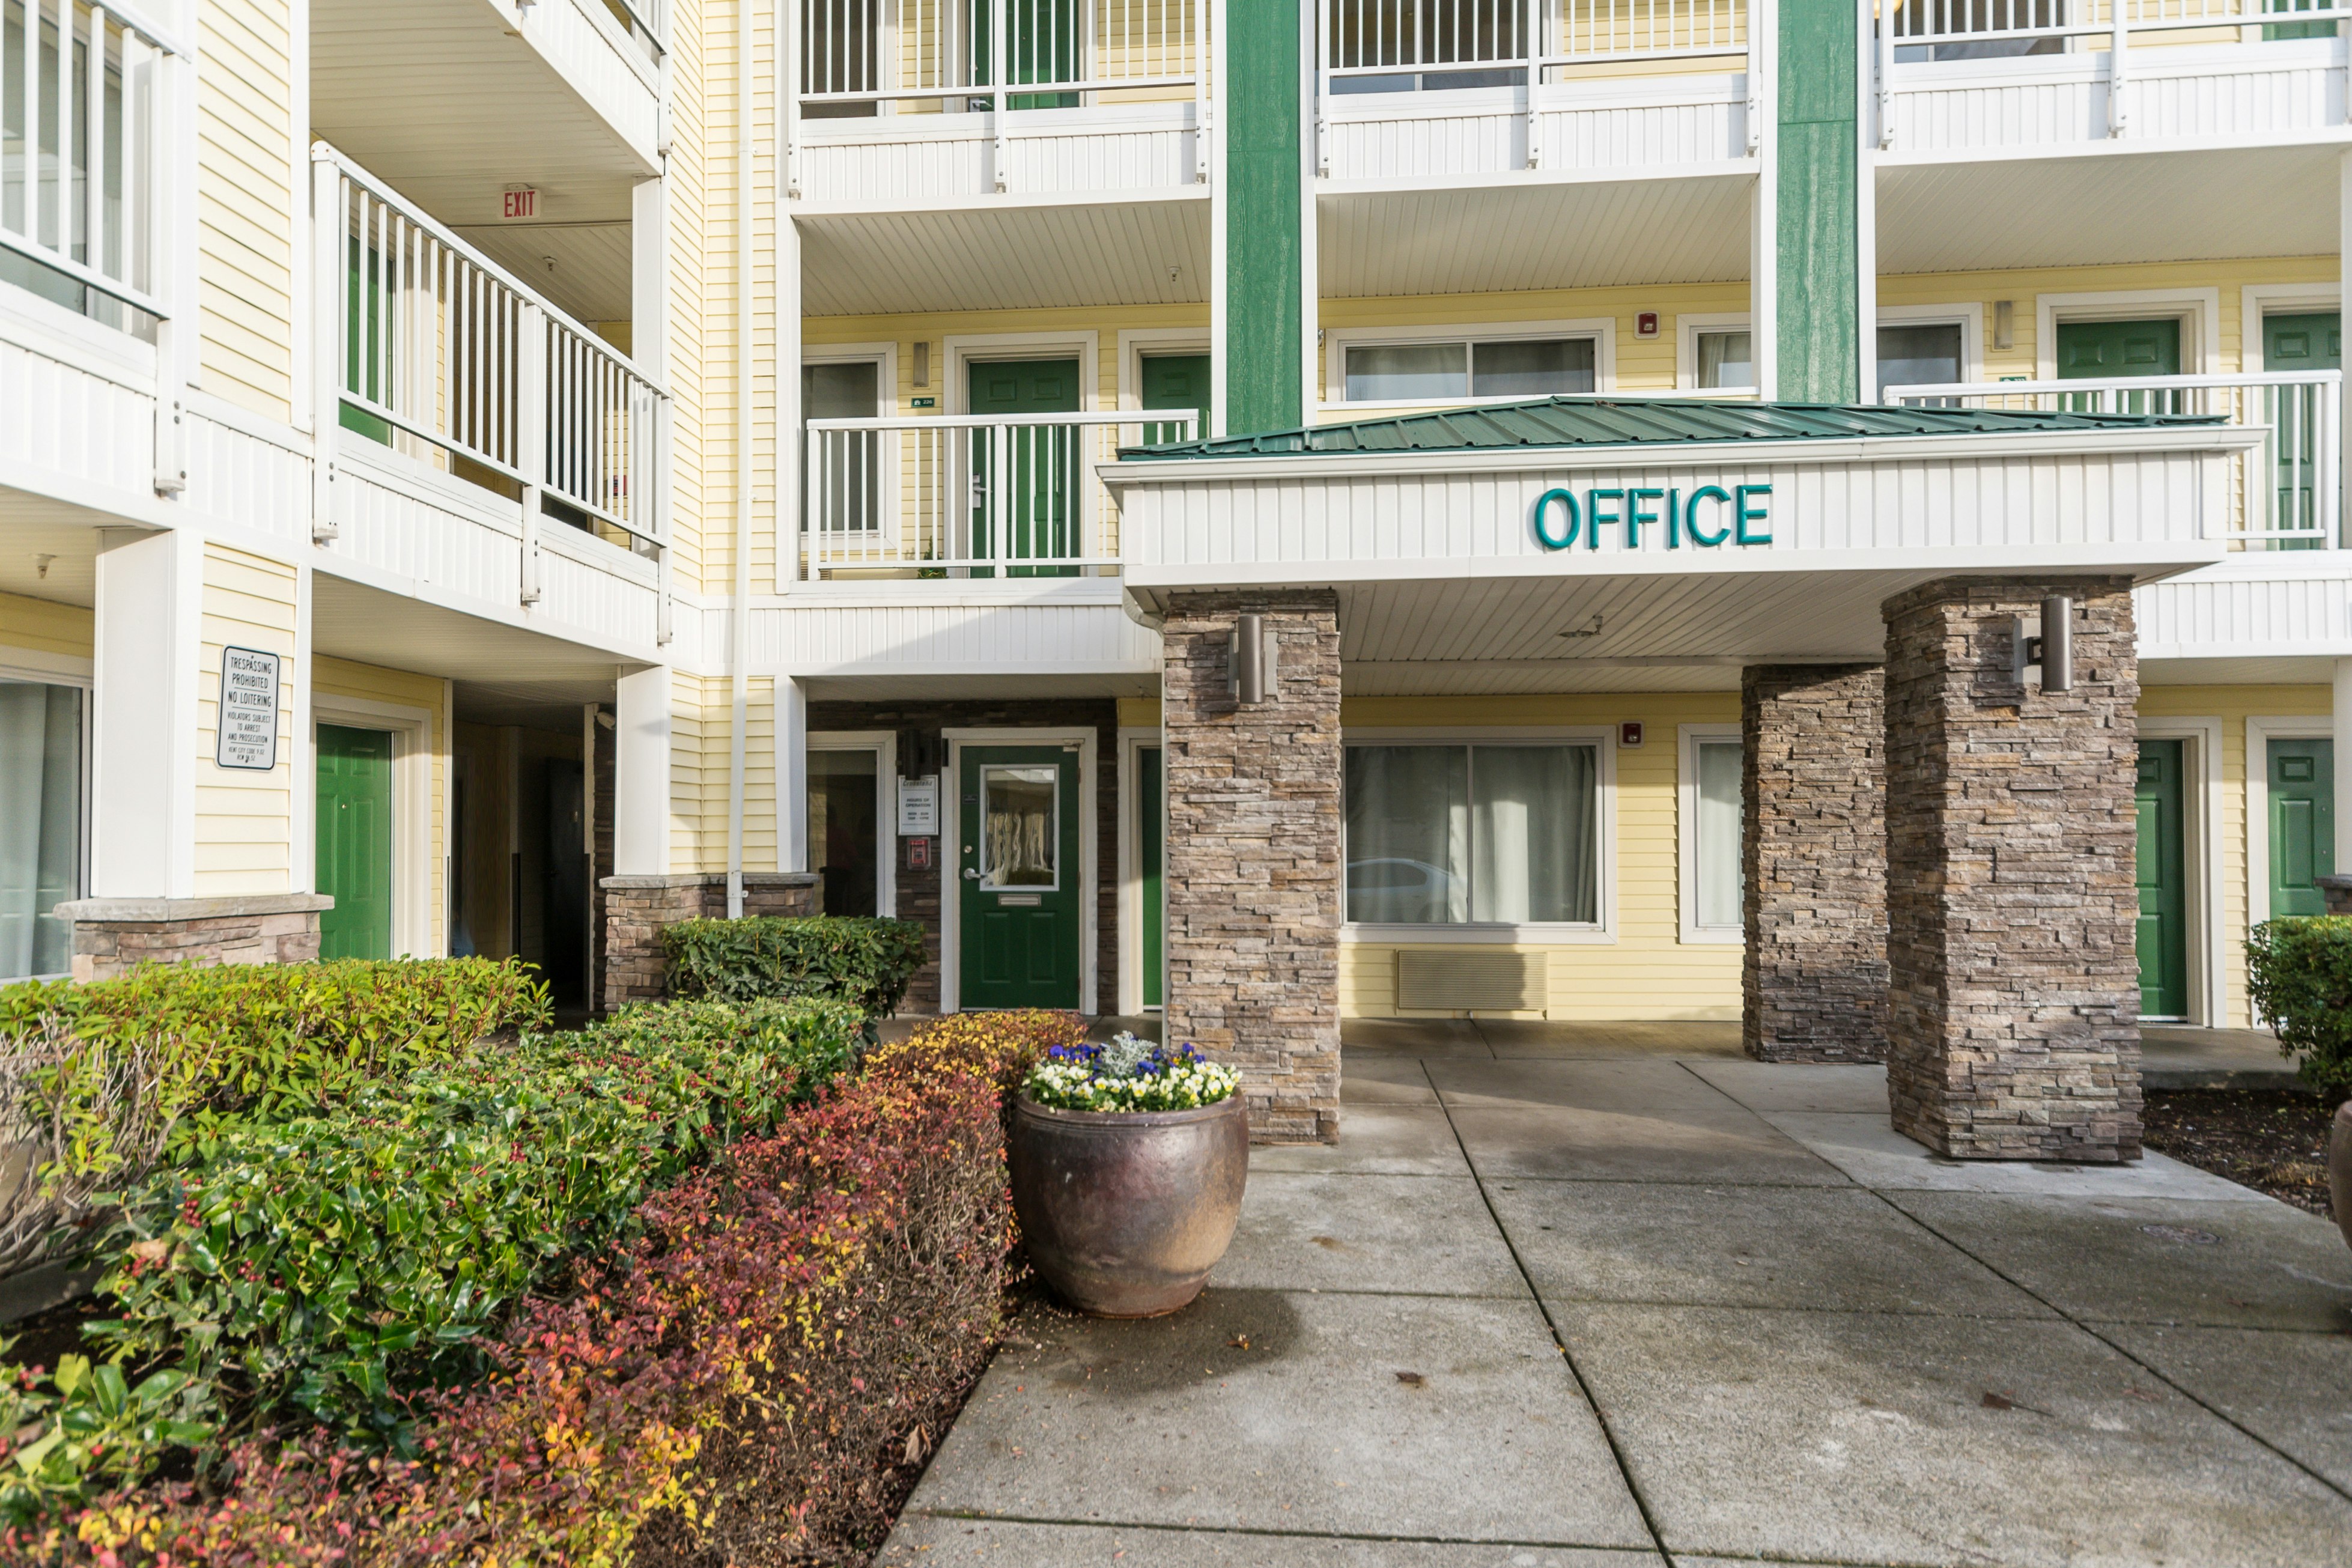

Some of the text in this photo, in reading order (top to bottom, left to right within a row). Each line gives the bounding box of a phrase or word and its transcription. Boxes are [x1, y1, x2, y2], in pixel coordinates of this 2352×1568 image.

[505, 191, 535, 217] EXIT
[1534, 484, 1773, 550] OFFICE
[231, 657, 272, 674] TRESPASSING
[232, 673, 269, 688] PROHIBITED
[228, 691, 272, 707] NO LOITERING
[228, 711, 271, 723] VIOLATORS SUBJECT
[244, 723, 261, 732] ARREST
[239, 734, 268, 743] PROSECUTION
